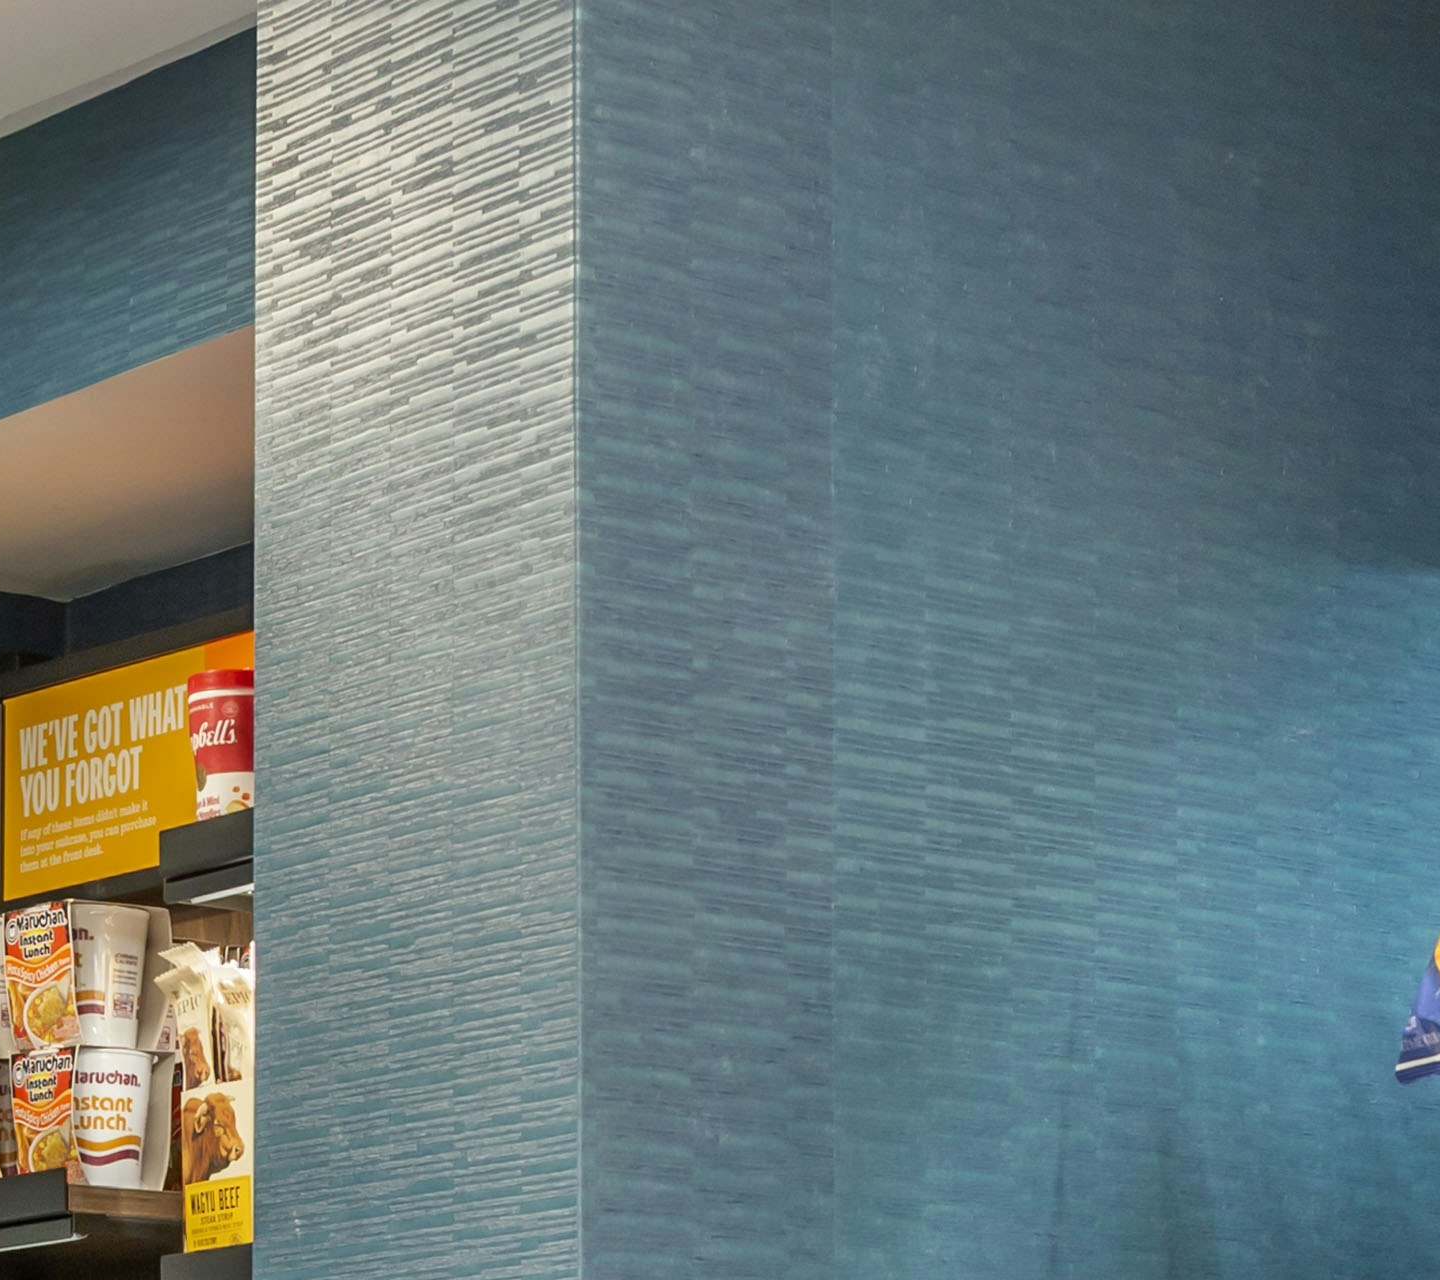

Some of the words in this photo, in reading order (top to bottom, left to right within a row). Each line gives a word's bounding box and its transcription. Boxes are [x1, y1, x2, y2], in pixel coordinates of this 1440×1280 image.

[19, 714, 79, 771] WE'VE
[83, 701, 124, 753] GOT
[129, 684, 187, 741] WHAT
[20, 767, 60, 818] YOU
[65, 745, 143, 807] FORGOT
[16, 910, 65, 930] Maruchan
[19, 931, 54, 946] Instant
[22, 944, 51, 959] Lunch
[29, 1089, 54, 1102] Lunch
[190, 1190, 215, 1216] WAGYU
[218, 1186, 241, 1210] BEEF
